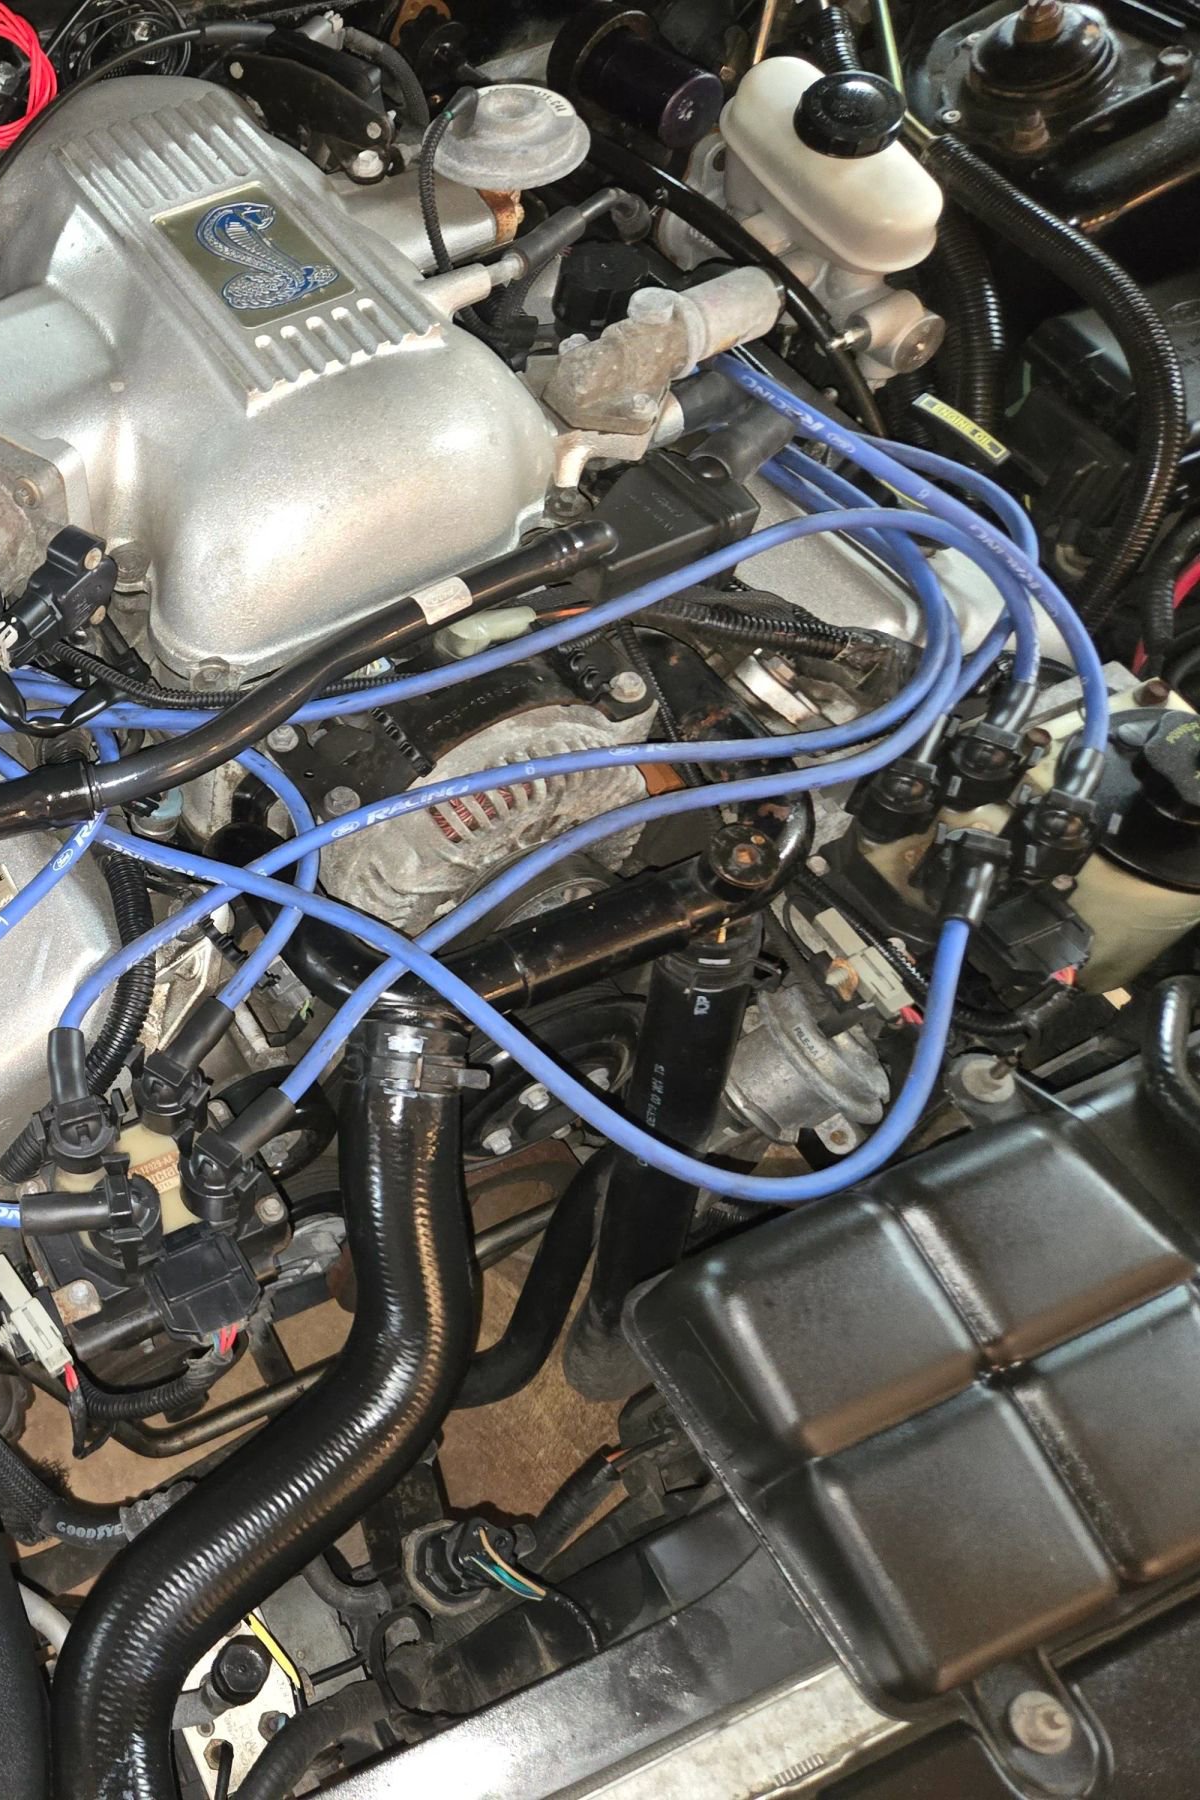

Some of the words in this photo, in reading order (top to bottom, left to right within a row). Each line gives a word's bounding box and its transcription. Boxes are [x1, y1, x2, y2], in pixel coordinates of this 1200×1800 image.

[741, 375, 825, 432] RACING
[932, 404, 972, 432] ENGINE
[975, 431, 991, 449] OIL
[366, 784, 469, 825] RACING
[56, 1521, 123, 1540] GOODYE
